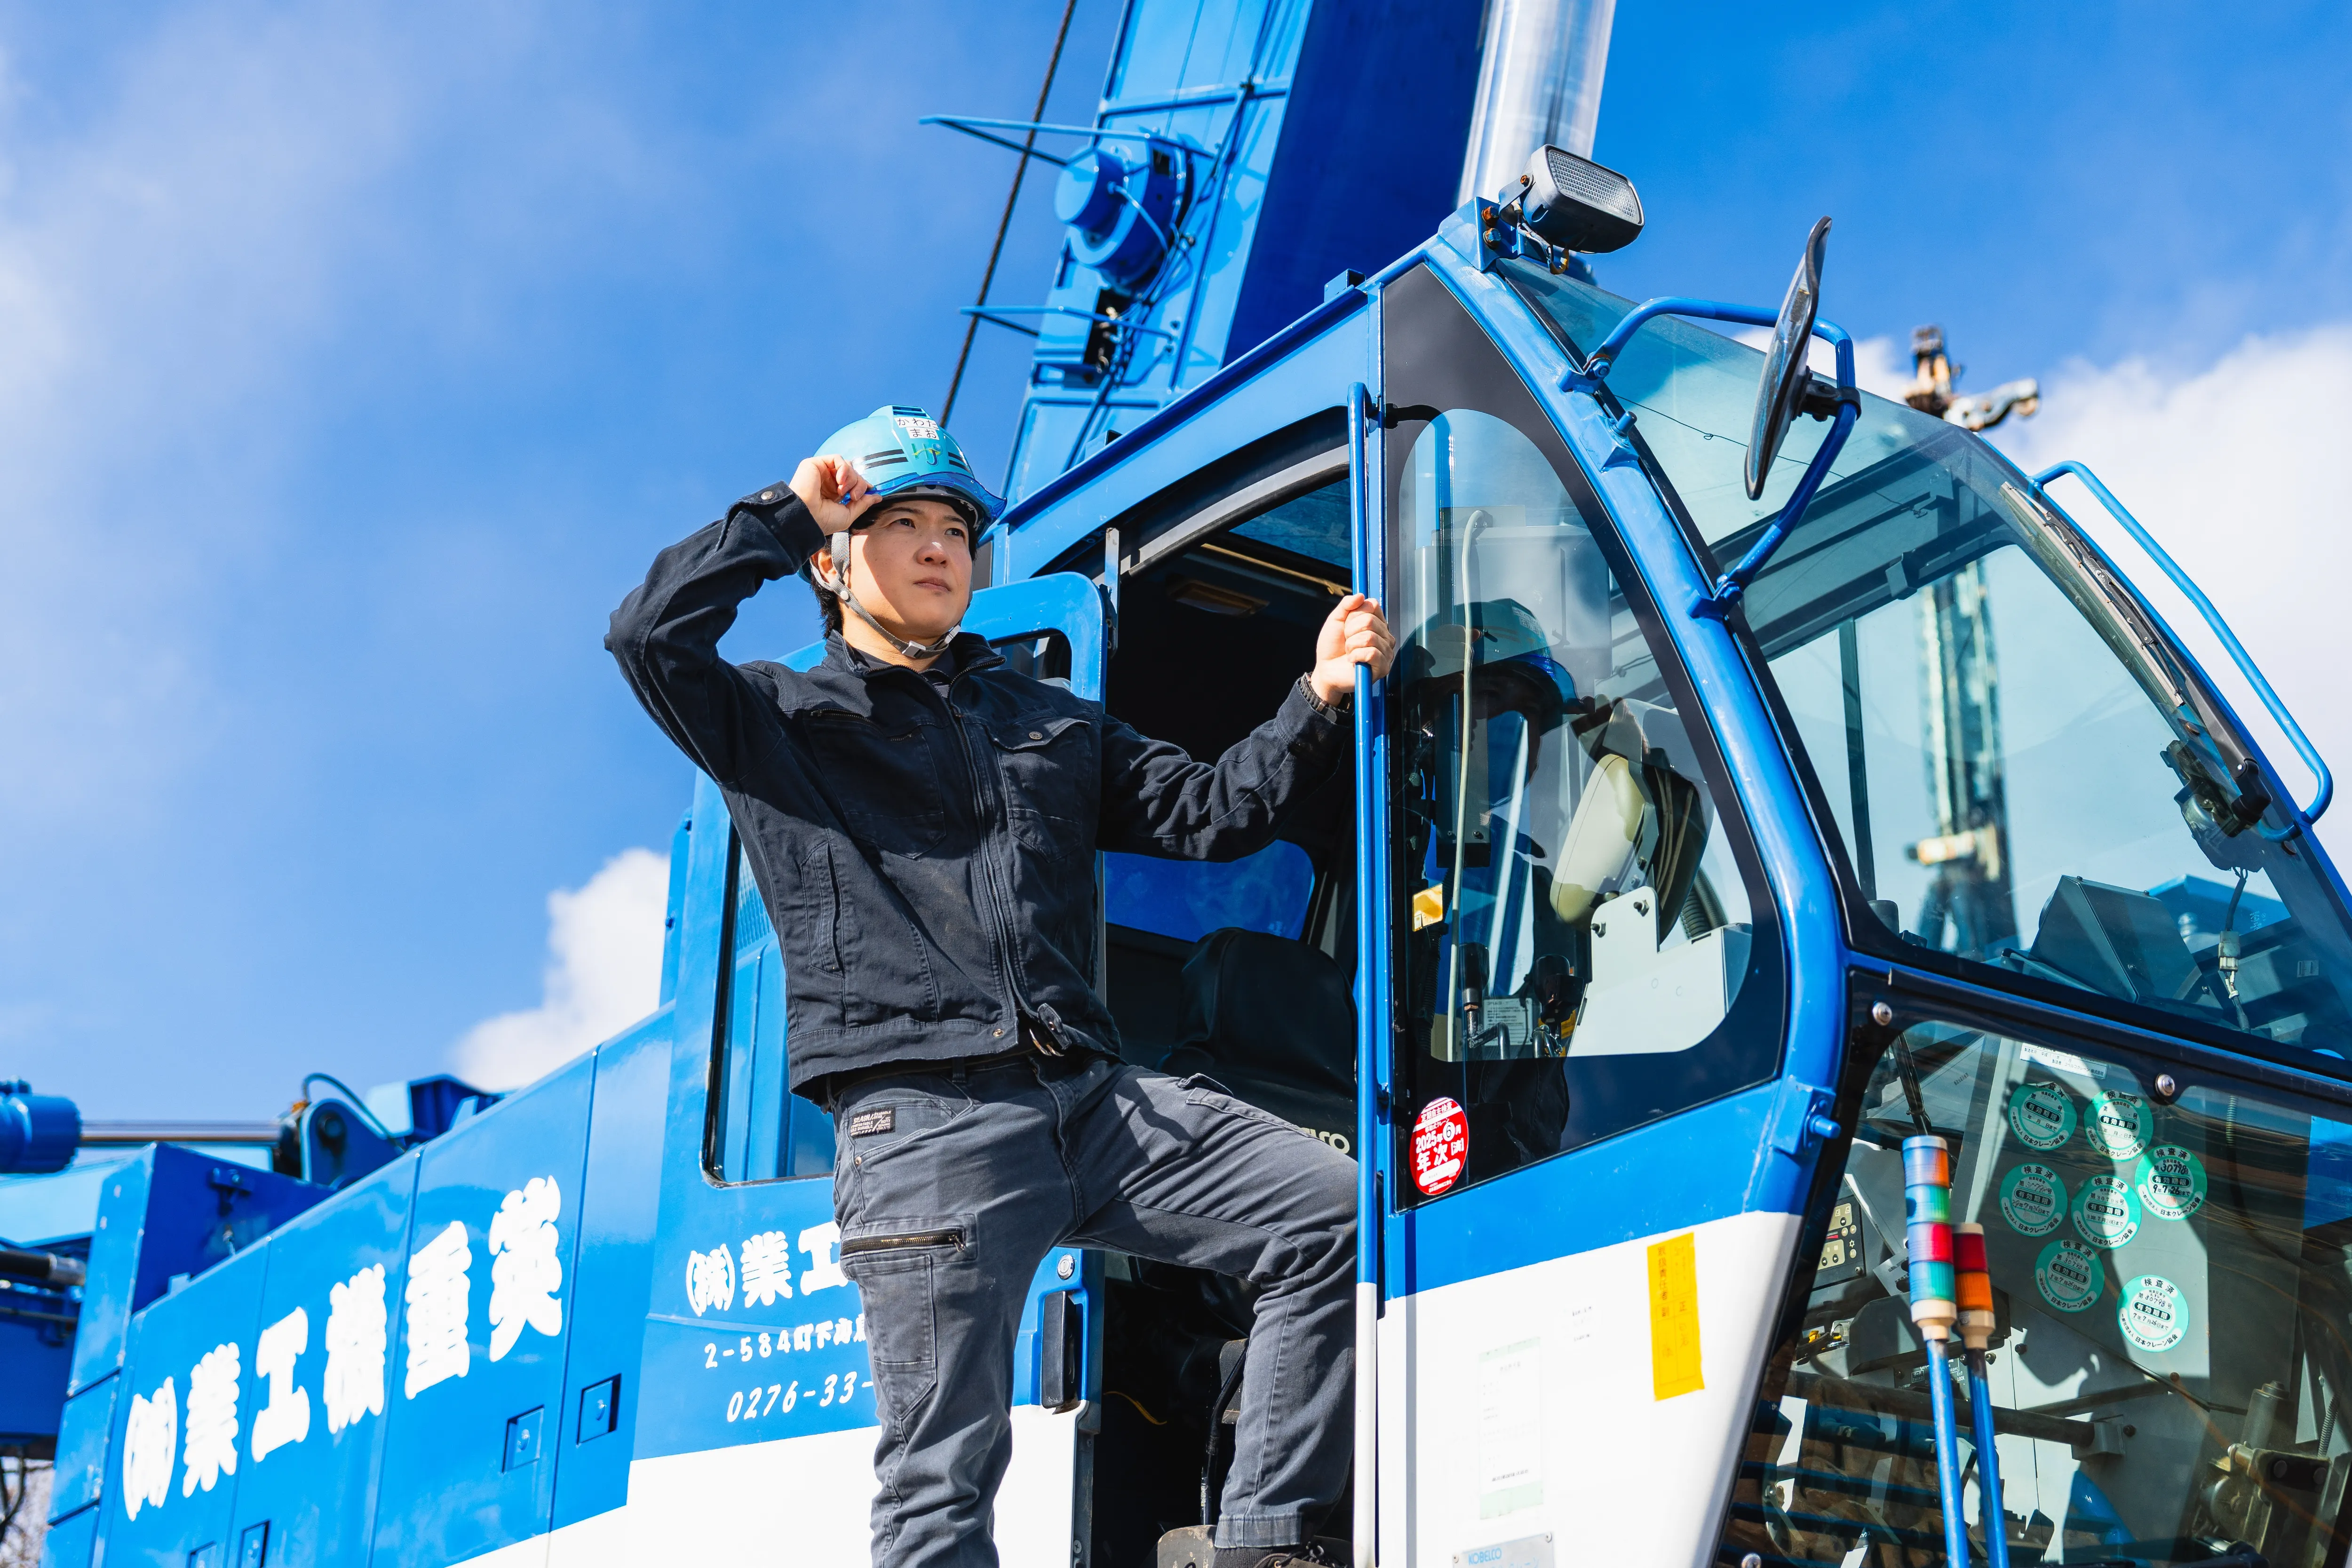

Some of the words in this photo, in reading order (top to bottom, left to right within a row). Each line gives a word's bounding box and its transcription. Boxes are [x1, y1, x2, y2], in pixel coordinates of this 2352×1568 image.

[897, 418, 939, 429] かわた
[910, 428, 937, 438] まお
[2029, 1103, 2057, 1121] 有効期限
[2103, 1116, 2133, 1129] 有効期限
[2024, 1135, 2065, 1146] 日本クレーン協会
[2100, 1143, 2143, 1156] 日本クレーン協会
[2156, 1147, 2188, 1160] 検査済
[2024, 1166, 2053, 1180] 検査済
[2094, 1177, 2124, 1190] 検査済
[2155, 1176, 2186, 1185] 有効期限
[2019, 1191, 2048, 1205] 有効期限
[2090, 1204, 2121, 1216] 有効期限
[2161, 1196, 2201, 1217] 日本クレーン協会
[2018, 1218, 2059, 1233] 日本クレーン協会
[2092, 1229, 2133, 1245] 日本クレーン協会
[2063, 1240, 2092, 1258] 検査済
[2055, 1265, 2084, 1282] 有効期限
[2144, 1278, 2175, 1294] 検査済
[2051, 1296, 2093, 1308] 日本クレーン協会
[2137, 1303, 2168, 1320] 有効期限
[2135, 1334, 2178, 1347] 日本クレーン協会
[1468, 1547, 1502, 1565] KOBELCO
